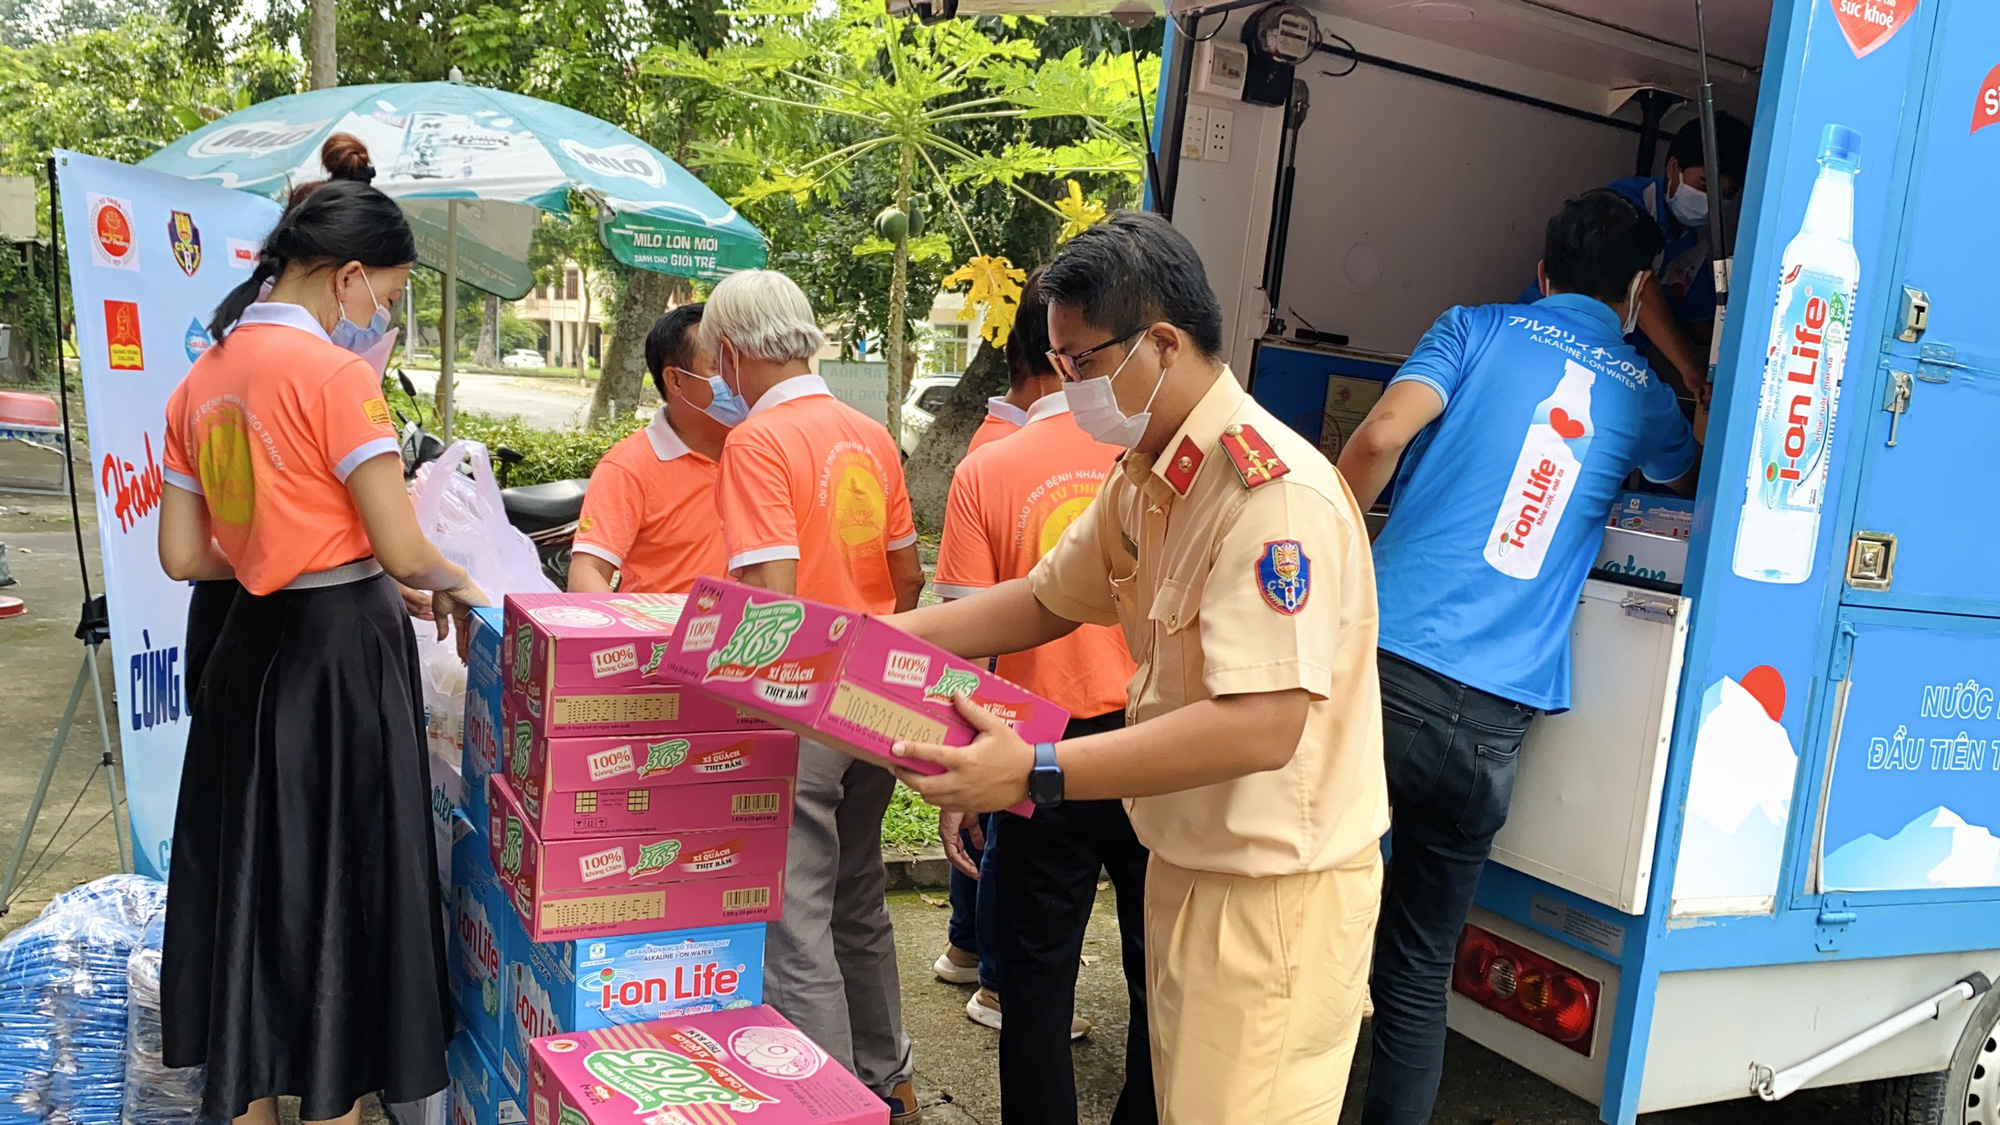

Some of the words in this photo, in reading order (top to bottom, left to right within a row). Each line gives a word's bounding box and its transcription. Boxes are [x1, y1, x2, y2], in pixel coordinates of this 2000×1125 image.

[210, 129, 316, 148] MILO
[571, 147, 653, 177] MILO
[633, 233, 663, 248] MILO
[666, 234, 691, 250] LON
[694, 234, 719, 252] MỚI
[654, 255, 668, 264] CHO
[670, 251, 693, 267] GIỚI
[694, 253, 717, 269] TRẺ
[1788, 297, 1826, 385] Life
[1529, 333, 1581, 360] ALKALINE
[1582, 355, 1605, 373] I-ON
[1606, 367, 1636, 391] WATER
[1027, 485, 1045, 505] TRỢ
[1045, 471, 1073, 489] BỆNH
[1075, 469, 1105, 481] NHÂN
[1522, 458, 1557, 504] Life
[689, 619, 717, 637] 100%
[718, 617, 800, 668] 365
[596, 648, 634, 666] 100%
[891, 654, 926, 674] 100%
[130, 629, 180, 732] CÙNG
[767, 666, 779, 681] XÍ
[780, 666, 815, 684] QUÁCH
[765, 685, 785, 702] THỊT
[1921, 679, 1994, 720] NƯỚC
[992, 706, 1017, 719] QUÁCH
[702, 756, 712, 764] XÍ
[713, 750, 740, 763] QUÁCH
[1867, 725, 1925, 771] ĐẦU
[1930, 731, 1987, 771] TIÊN
[593, 750, 630, 770] 100%
[646, 746, 686, 770] 365
[594, 768, 614, 777] Không
[614, 763, 631, 772] Chiên
[705, 765, 723, 773] THỊT
[584, 851, 621, 870] 100%
[638, 847, 678, 871] 365
[693, 853, 702, 862] XÍ
[703, 848, 730, 861] QUÁCH
[585, 869, 605, 878] Không
[605, 863, 622, 872] Chiên
[695, 862, 713, 870] THỊT
[478, 920, 498, 981] Life
[626, 948, 646, 956] JAPAN
[649, 943, 685, 954] ADVANCED
[686, 939, 730, 949] TECHNOLOGY
[643, 953, 673, 962] ALKALINE
[691, 949, 713, 957] WATER
[674, 963, 738, 999] Life
[659, 1009, 683, 1018] Healthy
[702, 1004, 713, 1012] for
[599, 1050, 740, 1103] 365
